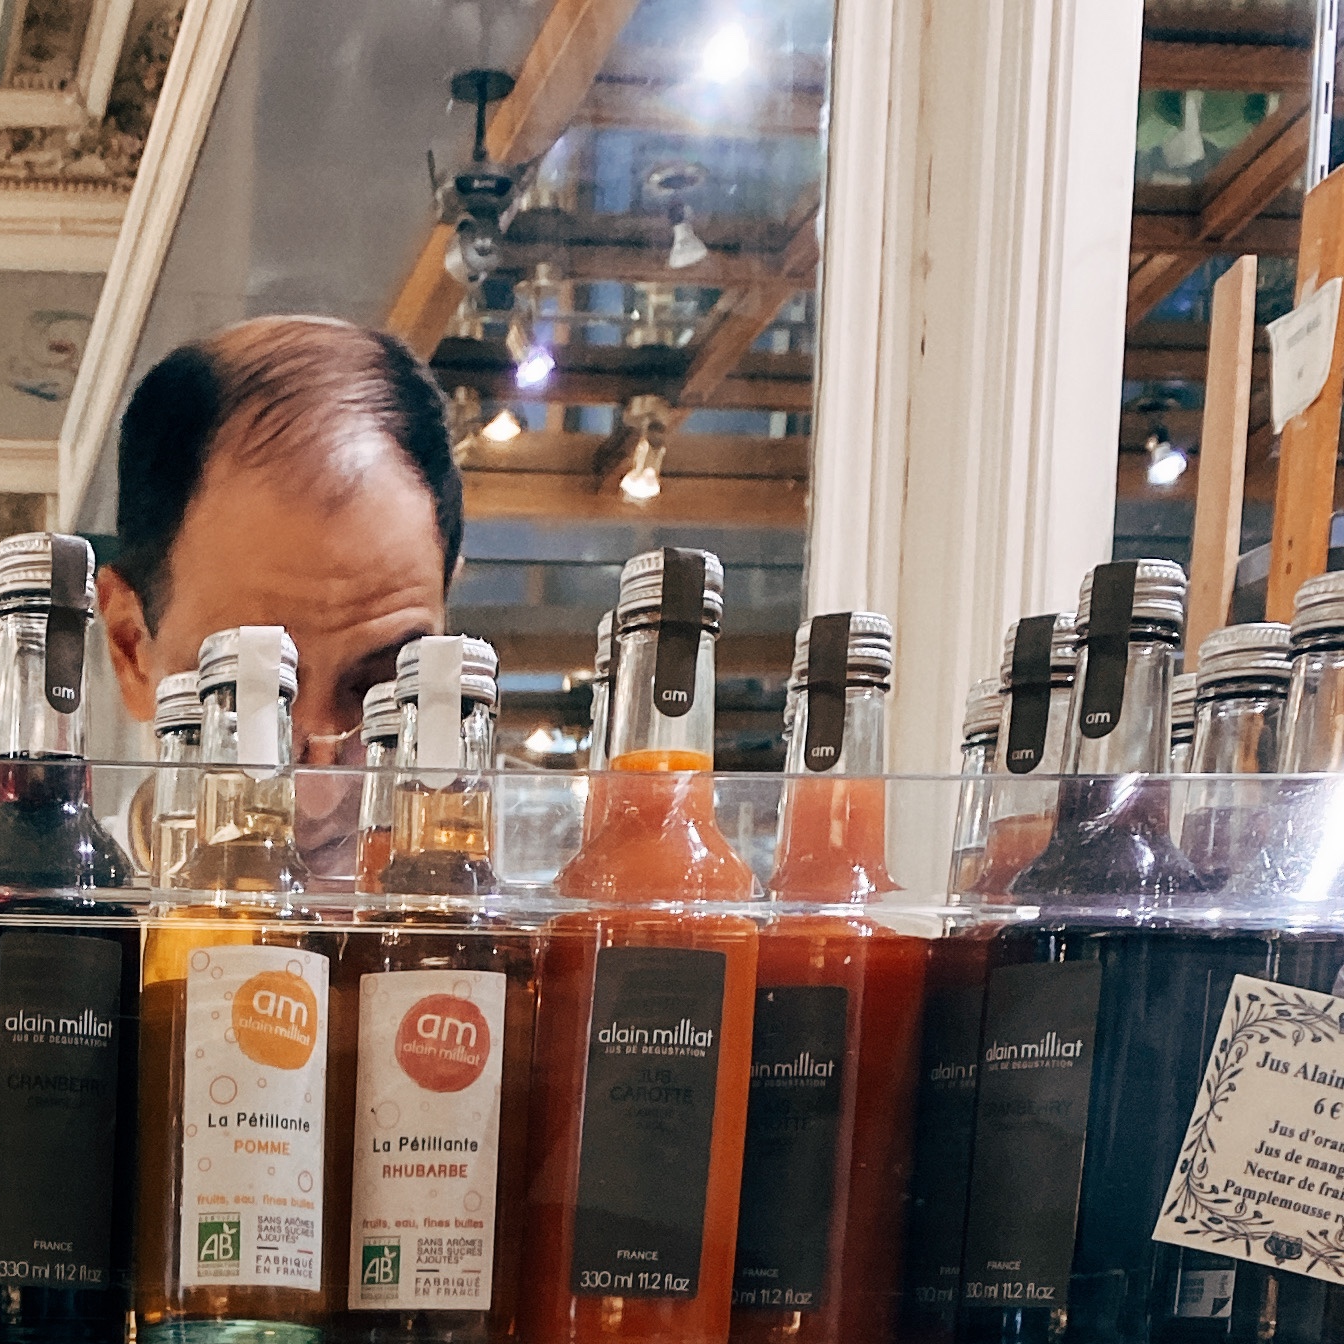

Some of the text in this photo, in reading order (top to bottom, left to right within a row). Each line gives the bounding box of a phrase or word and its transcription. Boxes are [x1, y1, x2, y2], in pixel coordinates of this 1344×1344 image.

[53, 686, 75, 700] am
[662, 690, 687, 702] am
[1086, 712, 1110, 725] am
[811, 745, 835, 757] am
[1012, 749, 1035, 761] am
[252, 989, 308, 1027] am
[5, 1007, 113, 1038] alain milliat
[239, 1016, 273, 1034] alain
[417, 1014, 477, 1047] am
[33, 1034, 45, 1043] DE
[598, 1018, 714, 1047] alain milliat
[403, 1041, 480, 1066] alain milliat
[626, 1045, 637, 1054] DE
[642, 1045, 706, 1058] DEGUSTATION
[986, 1031, 1083, 1062] alain milliat
[774, 1051, 835, 1077] milliat
[1256, 1051, 1344, 1090] Jus Alain
[1314, 1098, 1344, 1120] 6 €
[208, 1112, 310, 1132] La Pétillante
[1269, 1120, 1295, 1139] Jus
[234, 1139, 291, 1155] POMME
[373, 1136, 479, 1153] La Pétillante
[1255, 1140, 1280, 1159] Jus
[1284, 1149, 1302, 1164] de
[383, 1164, 468, 1178] RHUBARBE
[1243, 1160, 1295, 1186] Nectar
[1297, 1176, 1315, 1192] de
[1223, 1179, 1331, 1221] Pamplemousse
[257, 1215, 281, 1224] SANS
[423, 1217, 450, 1228] fines
[257, 1224, 282, 1233] SANS
[33, 1240, 74, 1252] FRANCE
[200, 1233, 233, 1260] AB
[417, 1238, 443, 1247] SANS
[417, 1247, 443, 1256] SANS
[617, 1250, 659, 1261] FRANCE
[32, 1263, 50, 1279] ml
[256, 1265, 313, 1279] EN FRANCE
[363, 1257, 394, 1283] AB
[987, 1260, 1021, 1271] FRANCE
[580, 1271, 612, 1288] 330
[614, 1272, 633, 1289] ml
[415, 1287, 480, 1297] EN FRANCE
